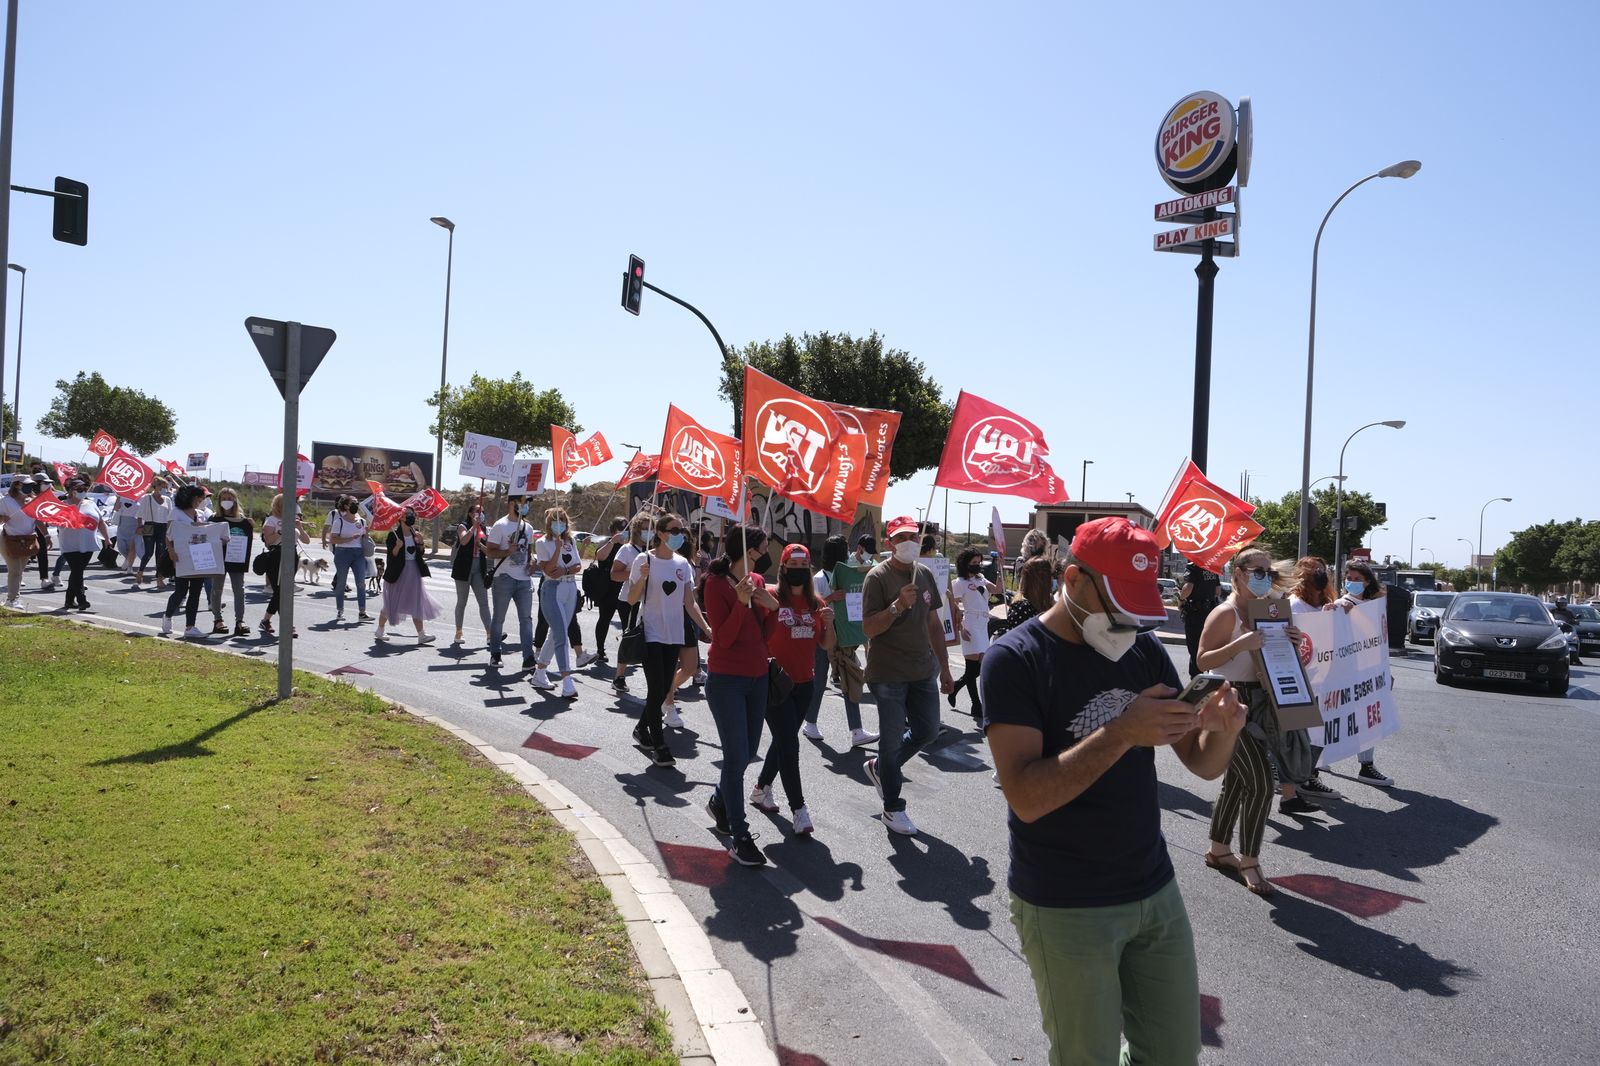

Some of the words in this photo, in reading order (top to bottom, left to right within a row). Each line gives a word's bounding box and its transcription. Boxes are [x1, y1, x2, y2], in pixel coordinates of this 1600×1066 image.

[1162, 101, 1218, 147] BURGER
[1164, 117, 1221, 170] KING
[1158, 188, 1229, 217] AUTOKING
[1157, 228, 1188, 247] PLAY
[1194, 219, 1228, 239] KING
[677, 431, 715, 472] UGT
[763, 409, 826, 472] UGT
[864, 423, 889, 491] www.ugt.es
[109, 459, 142, 484] UGT
[363, 463, 385, 473] KINGS
[1317, 651, 1334, 663] UGT
[1324, 717, 1340, 745] NO
[1347, 711, 1358, 736] AL
[1366, 701, 1381, 729] ERE
